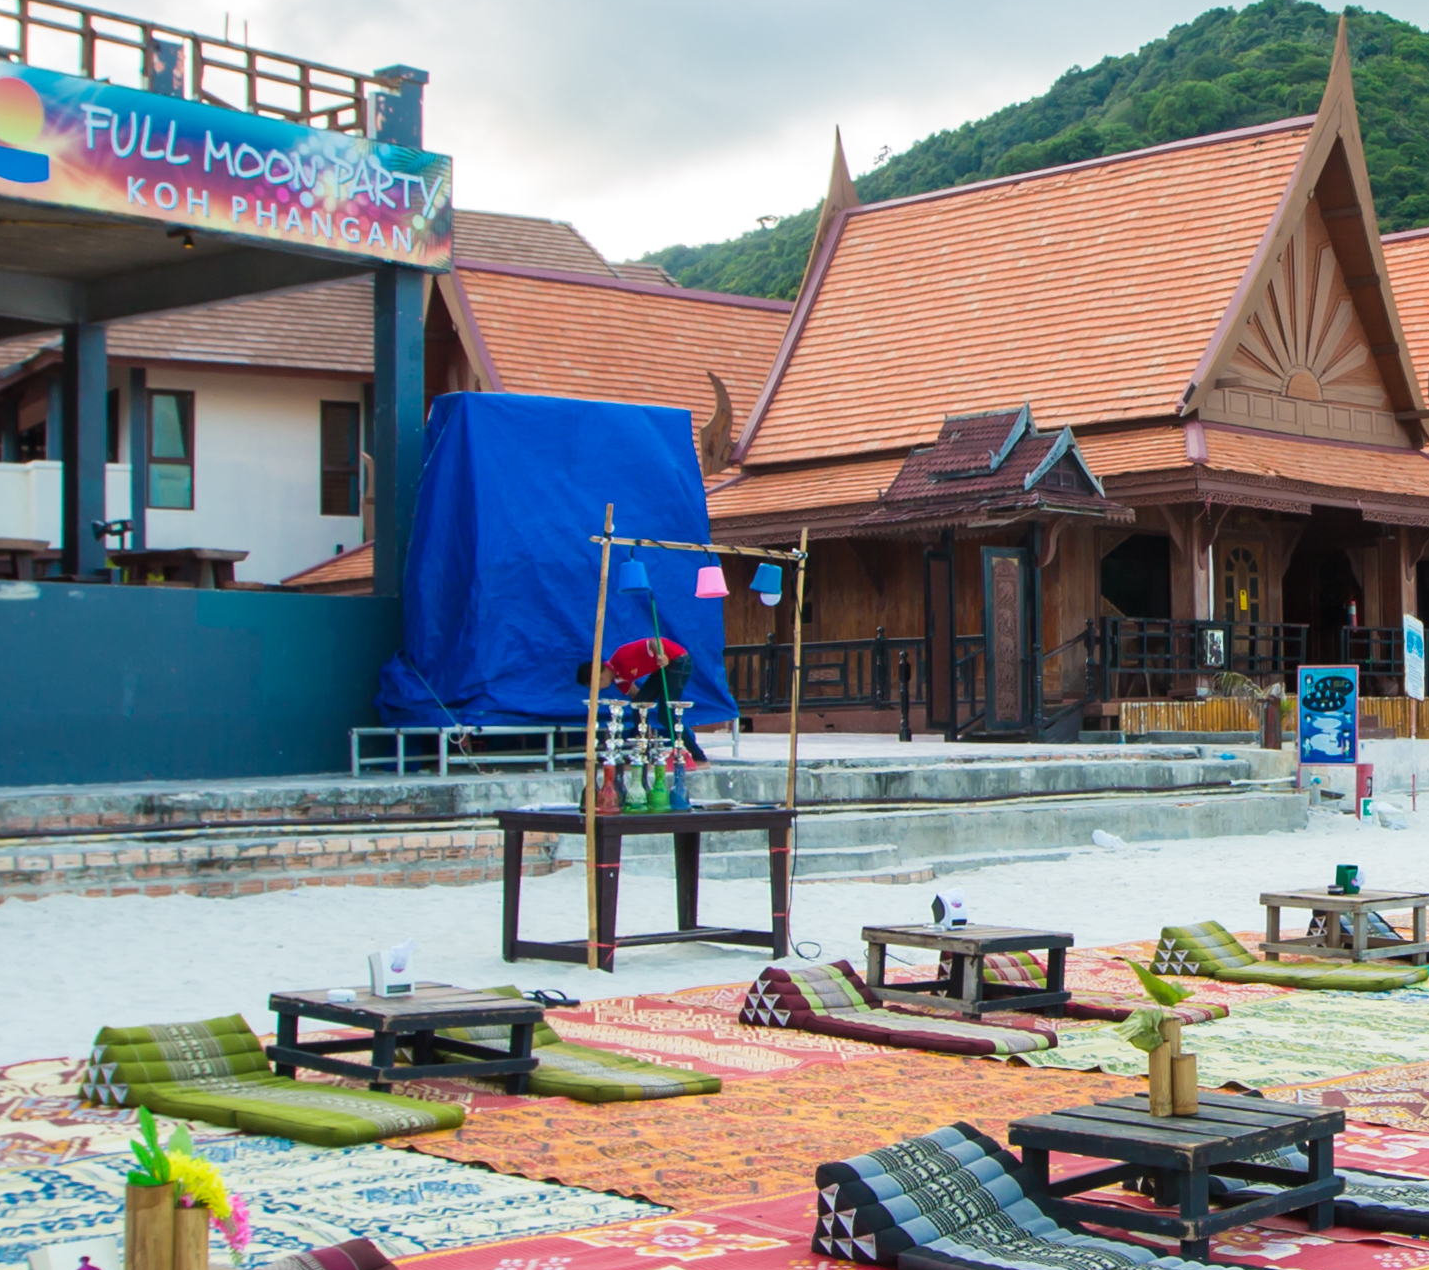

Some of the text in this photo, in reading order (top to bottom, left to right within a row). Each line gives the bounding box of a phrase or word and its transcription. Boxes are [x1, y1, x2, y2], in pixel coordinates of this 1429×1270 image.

[80, 103, 444, 219] FULL MOON PARTY
[127, 176, 414, 254] KOH PHANGAN
